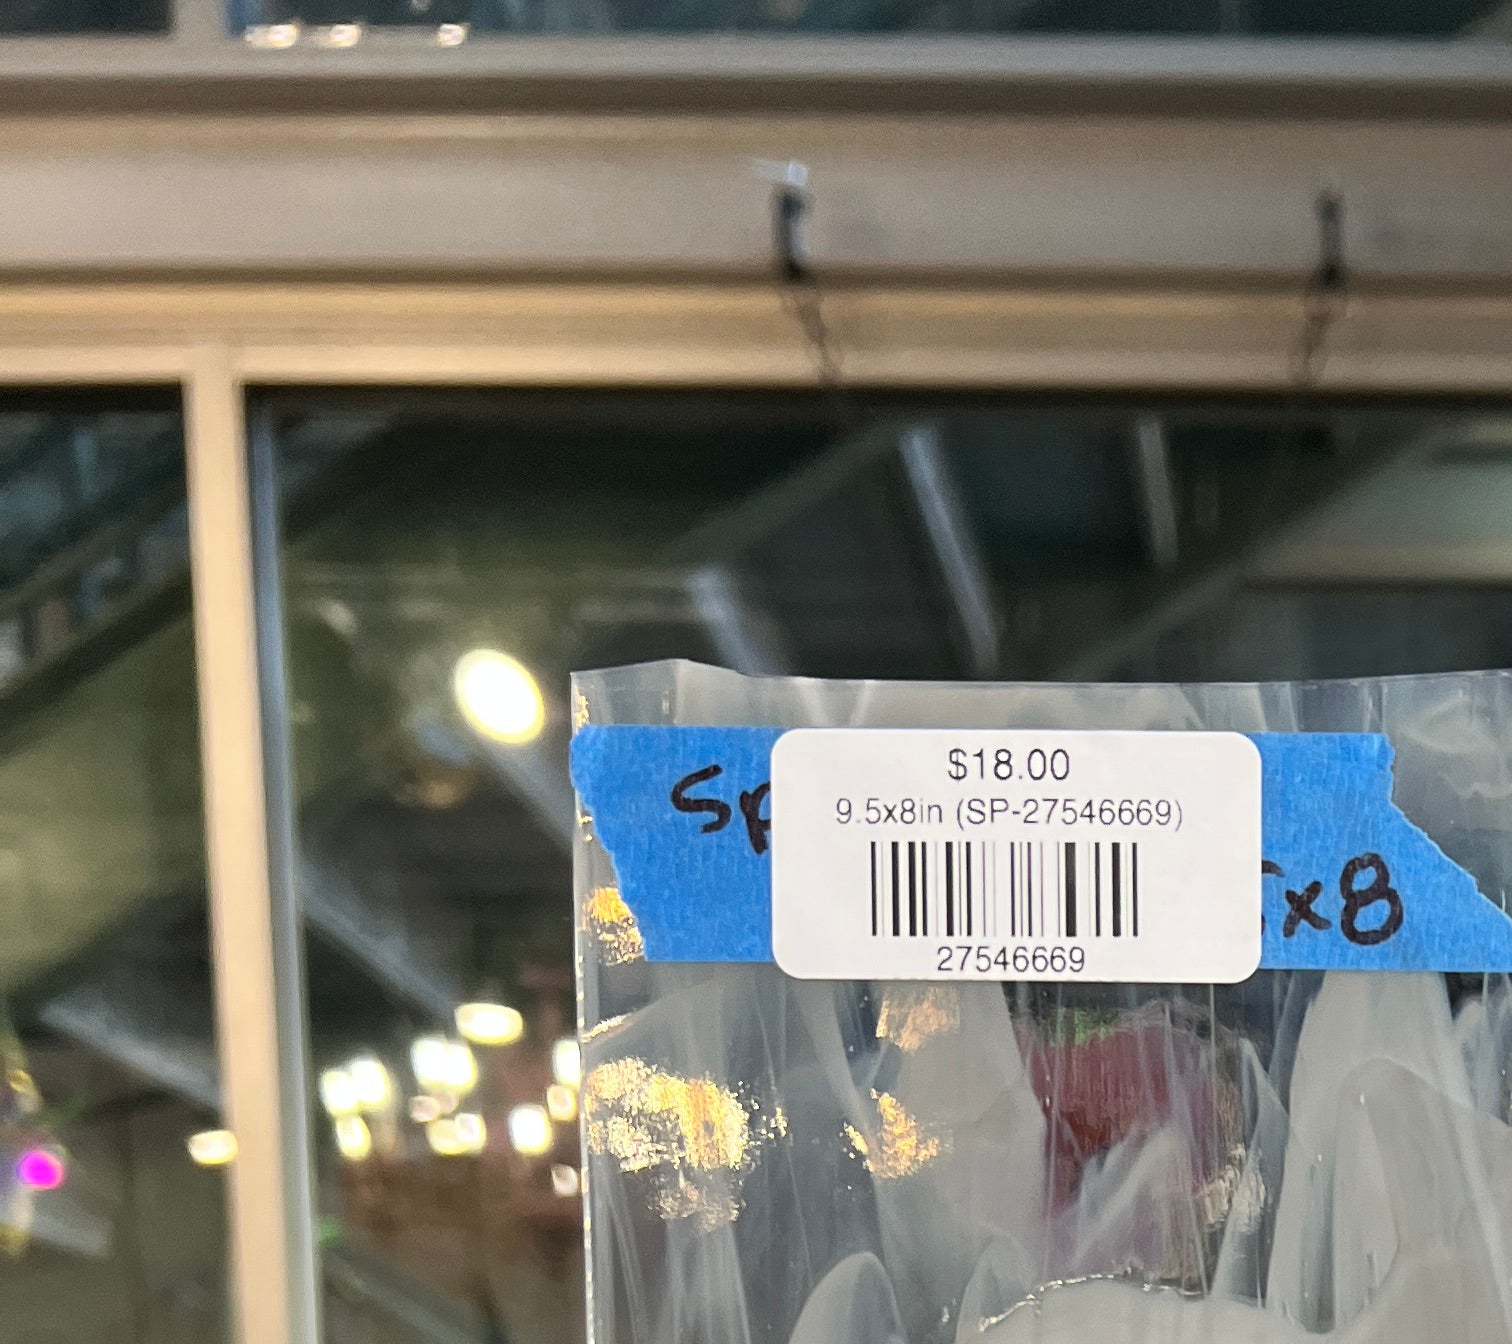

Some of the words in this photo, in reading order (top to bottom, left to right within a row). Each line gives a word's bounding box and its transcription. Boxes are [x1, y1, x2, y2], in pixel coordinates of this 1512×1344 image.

[947, 748, 1070, 782] $18.00
[836, 798, 943, 825] 9.5x8in
[956, 798, 1183, 832] (SP-27546669)
[937, 945, 1086, 973] 27546669
